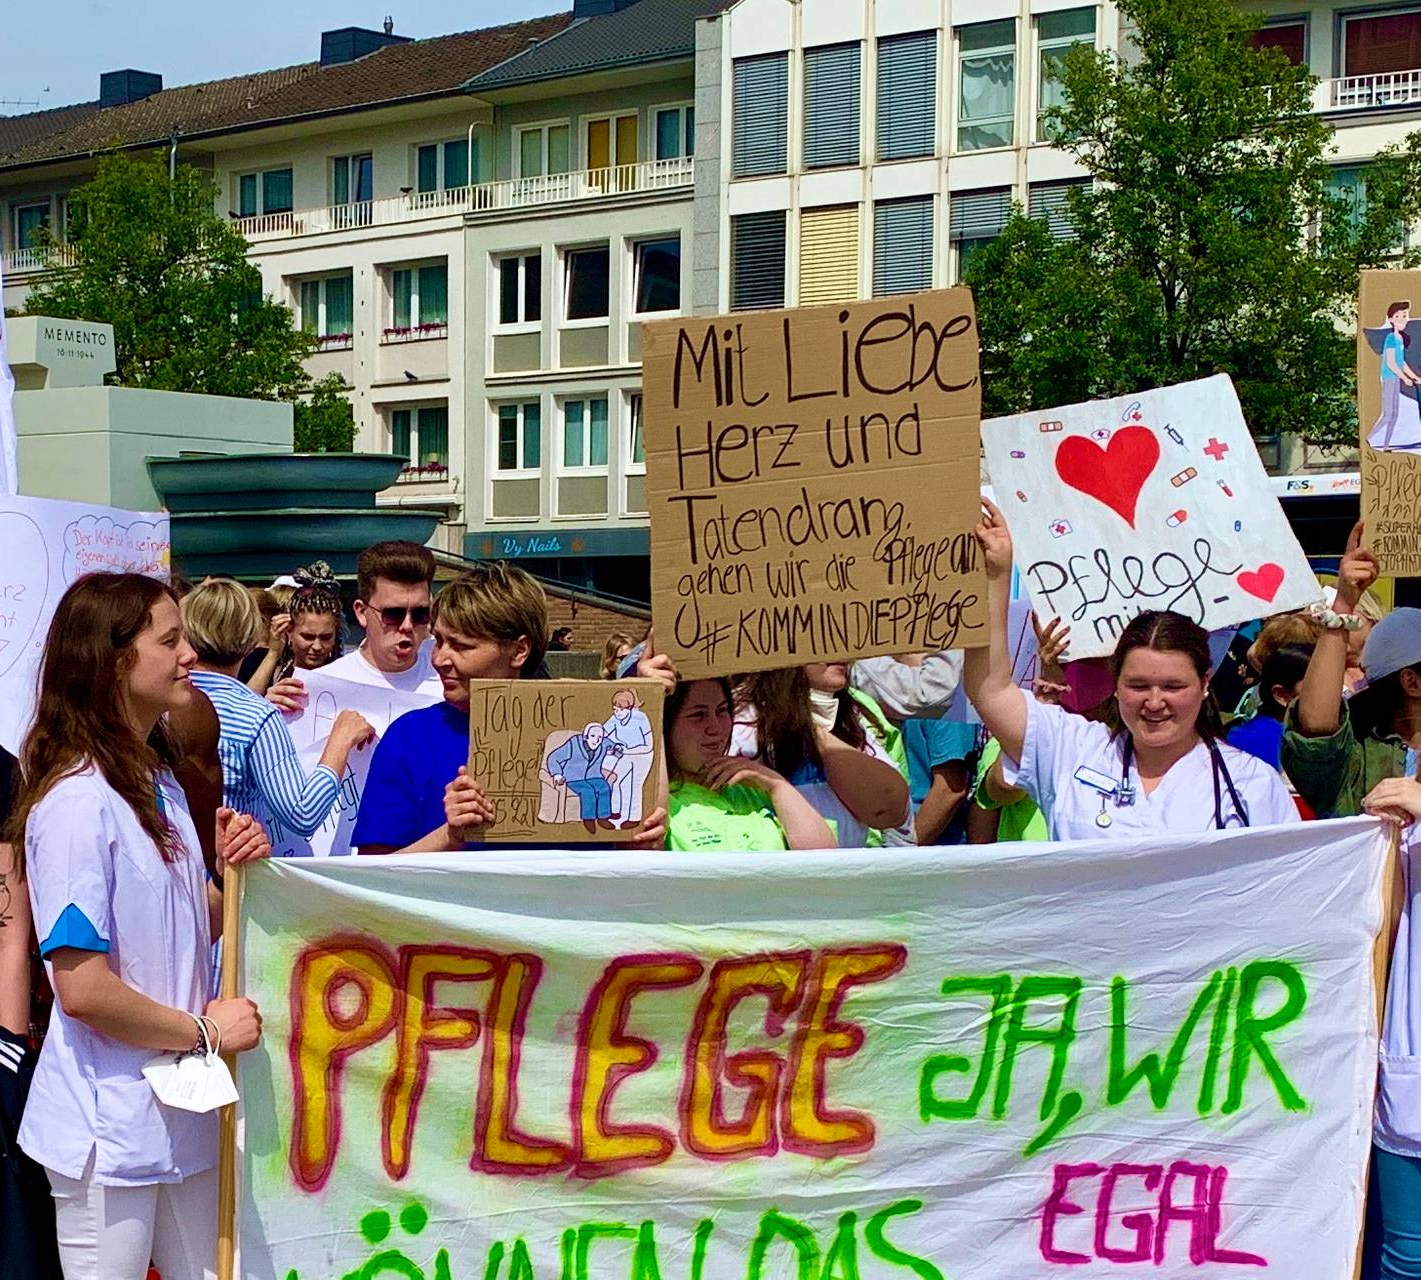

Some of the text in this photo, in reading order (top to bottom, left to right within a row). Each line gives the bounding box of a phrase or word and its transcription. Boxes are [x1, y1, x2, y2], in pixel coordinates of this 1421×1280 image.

[44, 328, 106, 346] MEMENTO
[674, 323, 769, 408] Mit
[676, 403, 922, 490] Herz und
[503, 537, 562, 557] Vy Nails
[1027, 538, 1243, 626] Pflege
[675, 562, 754, 648] gehen
[766, 551, 809, 599] wir
[826, 553, 859, 593] die
[882, 535, 949, 597] Pflege
[1092, 605, 1142, 643] mi
[478, 686, 574, 757] Tag der
[288, 934, 909, 1192] PFLEGE
[1106, 960, 1308, 1115] WIR
[1039, 1161, 1267, 1267] EGAL
